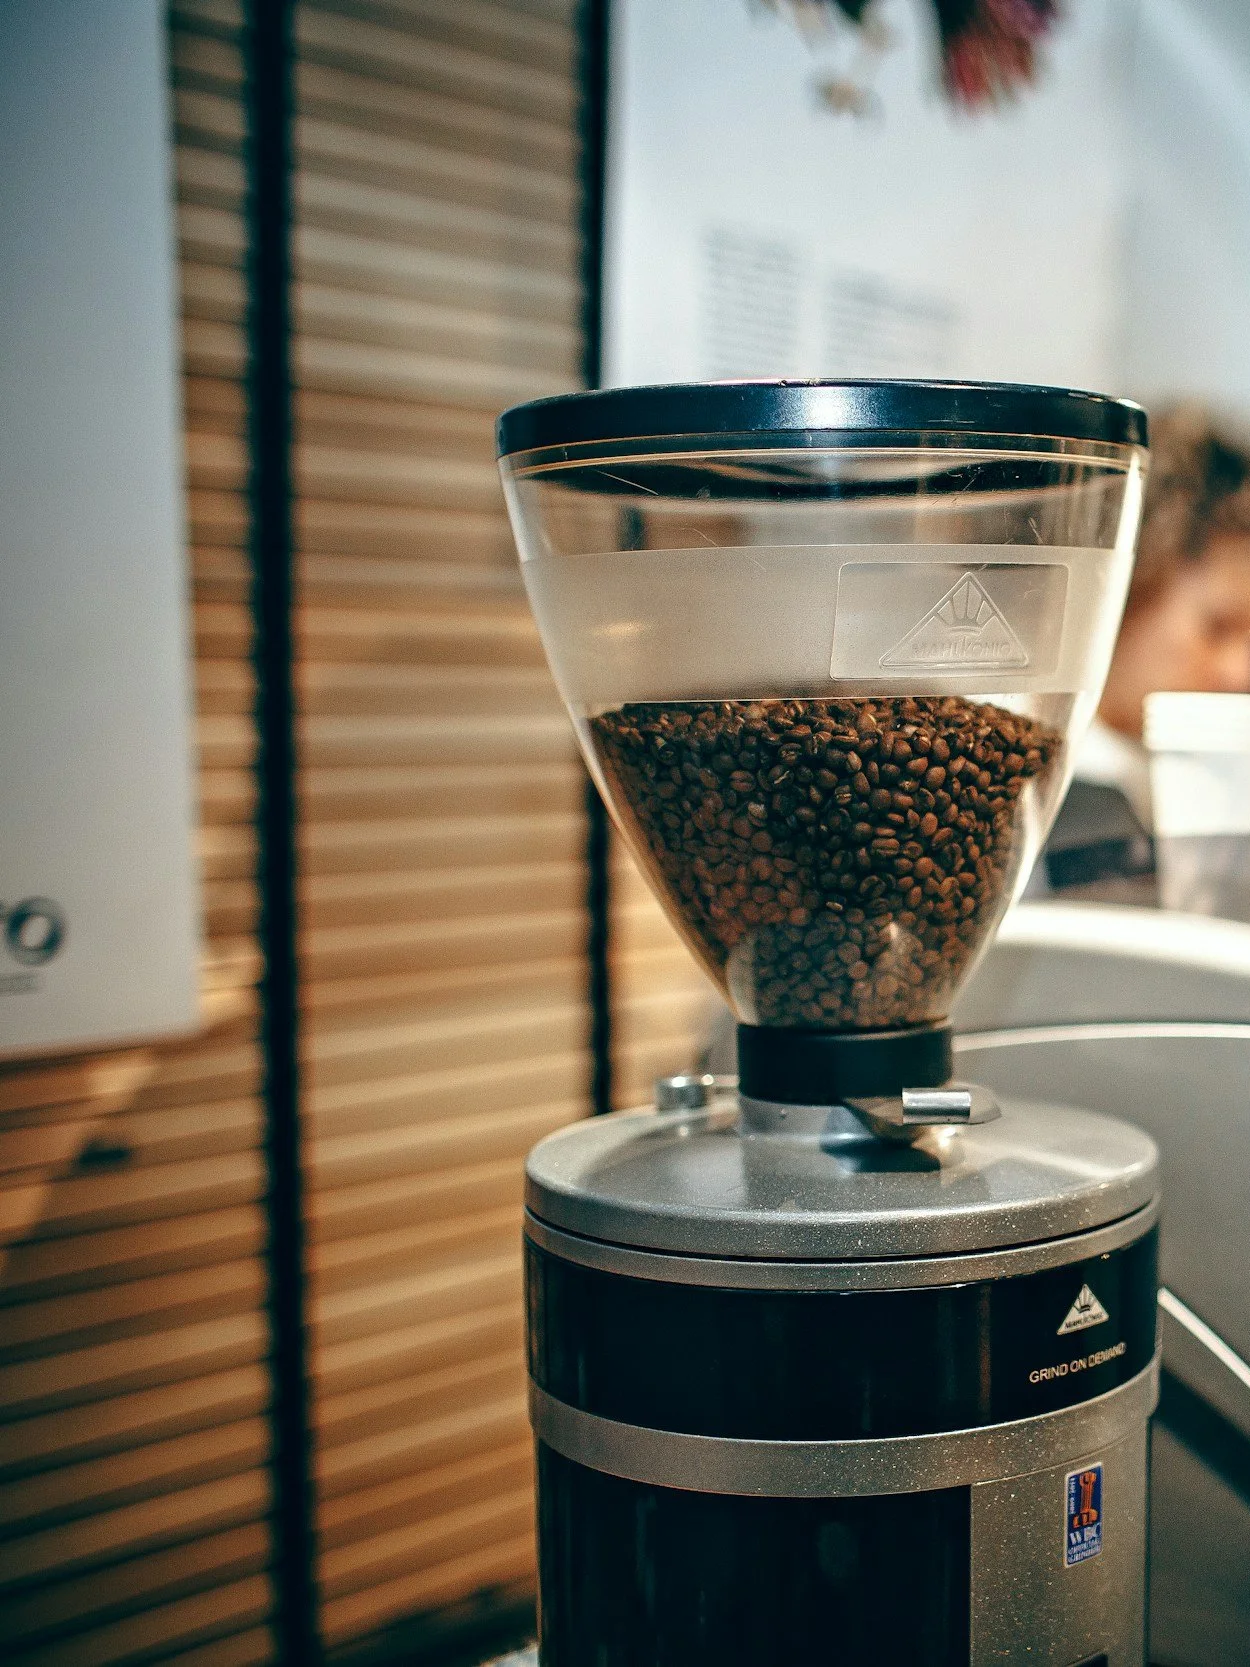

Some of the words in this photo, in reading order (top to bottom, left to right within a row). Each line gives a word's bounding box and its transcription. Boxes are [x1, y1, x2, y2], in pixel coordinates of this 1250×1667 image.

[1029, 1364, 1069, 1383] GRIND
[1069, 1358, 1087, 1373] ON
[1088, 1342, 1126, 1368] DEMAND
